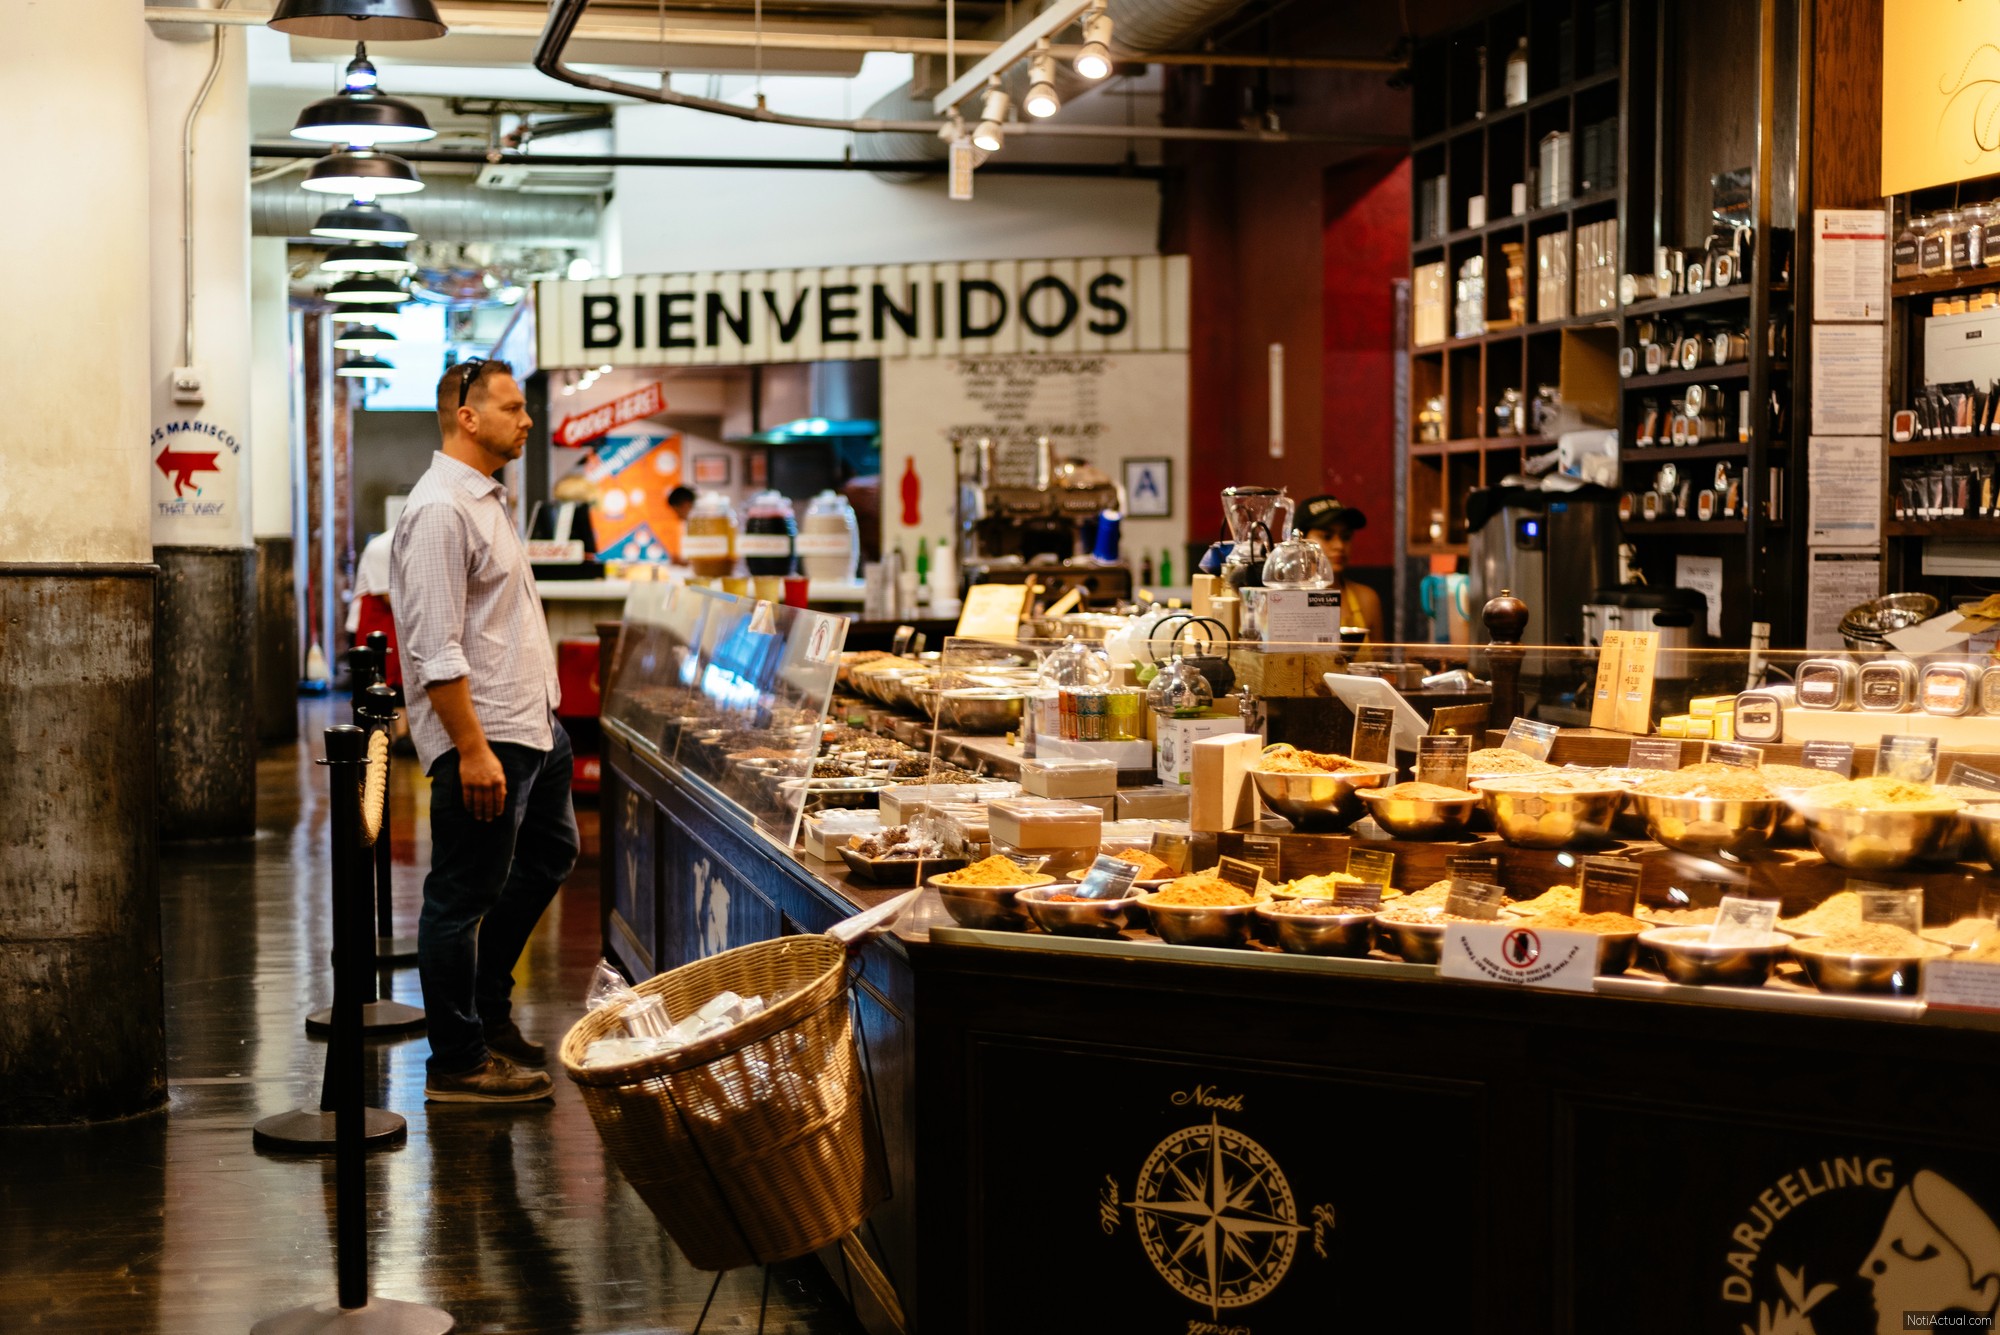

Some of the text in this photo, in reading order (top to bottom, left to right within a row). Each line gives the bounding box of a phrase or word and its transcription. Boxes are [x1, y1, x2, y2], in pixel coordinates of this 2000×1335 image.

[582, 273, 1127, 350] BIENVENIDOS
[166, 420, 241, 455] MARISCOS
[1135, 469, 1159, 500] A
[158, 502, 224, 516] THAT WAY
[1170, 1084, 1245, 1112] North
[1722, 1156, 1895, 1304] DARJEELING
